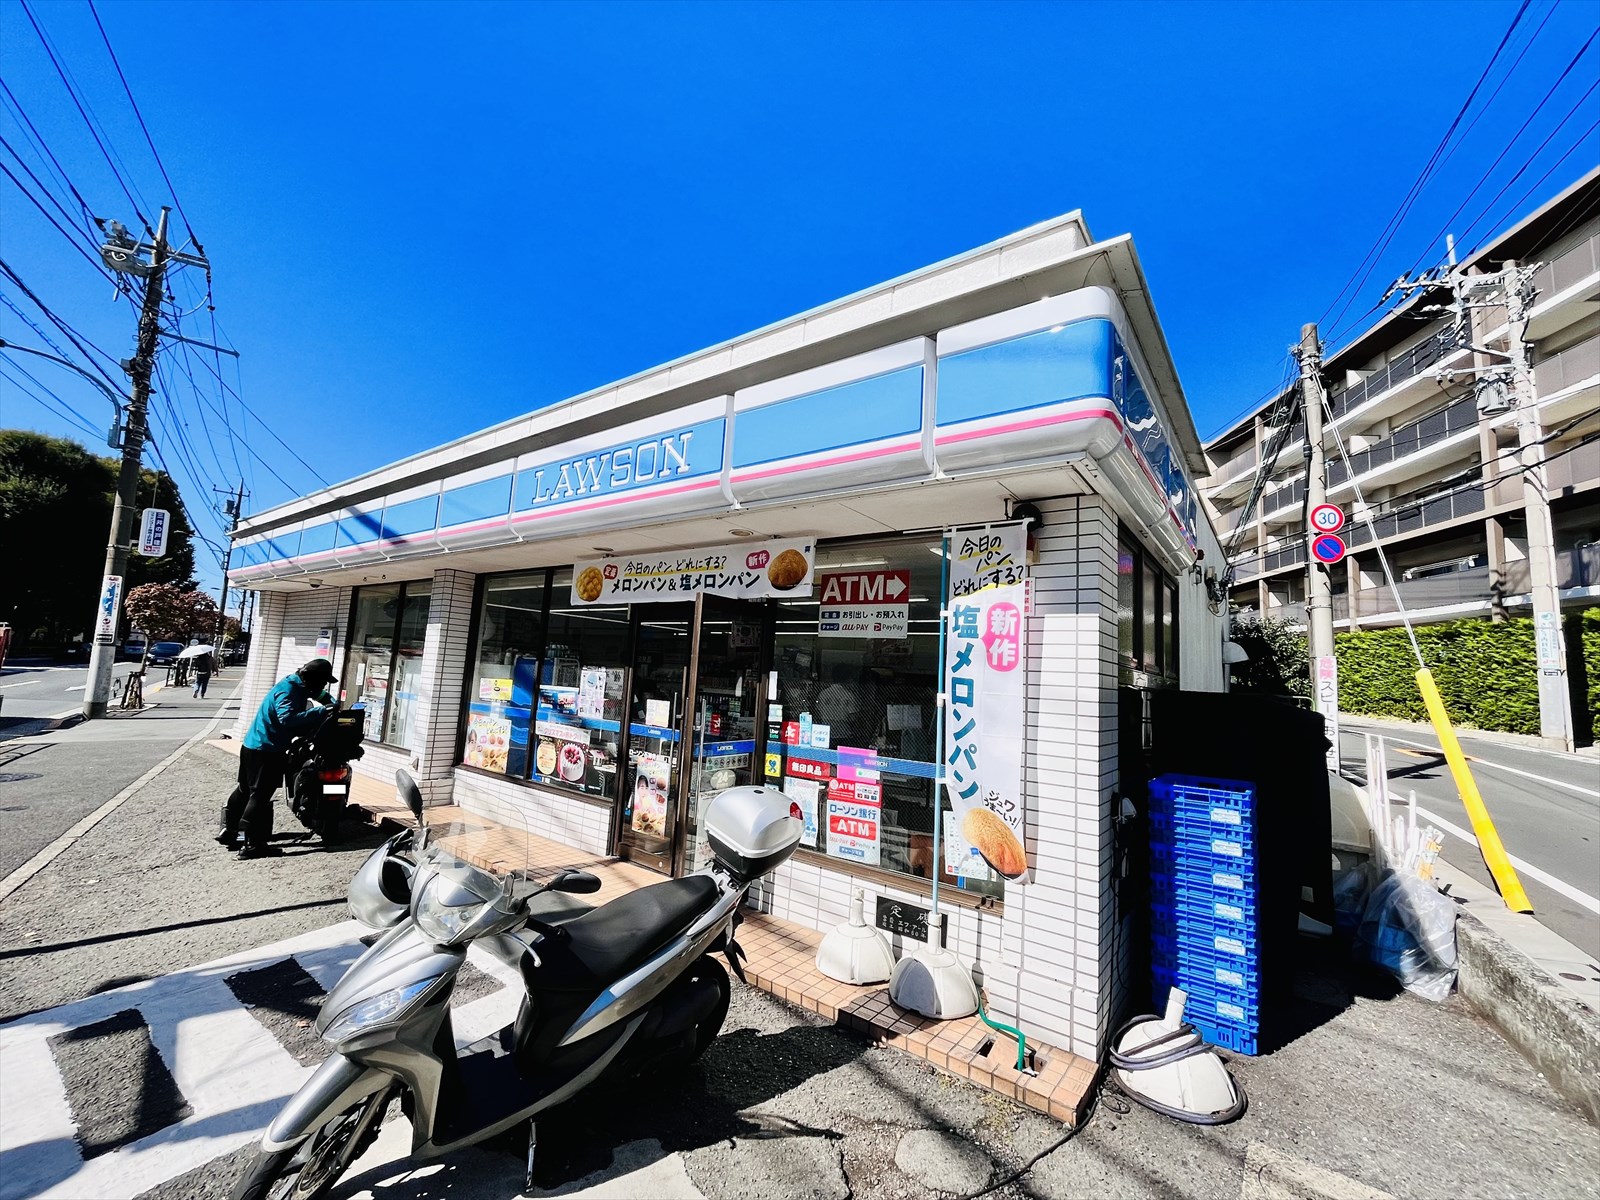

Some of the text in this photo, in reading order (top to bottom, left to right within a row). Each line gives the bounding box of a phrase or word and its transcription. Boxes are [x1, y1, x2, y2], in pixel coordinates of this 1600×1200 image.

[531, 430, 693, 505] LAWSON
[1318, 512, 1337, 525] 30
[960, 534, 1002, 558] 今日の
[748, 553, 768, 567] 新作
[822, 574, 885, 602] ATM
[953, 565, 1024, 596] どれにする?
[988, 607, 1018, 667] 新作
[948, 603, 980, 800] 塩メロンパン
[791, 761, 822, 776] 無印良品
[839, 782, 854, 791] ATM
[829, 803, 877, 820] ローソン銀行
[837, 818, 869, 837] ATM
